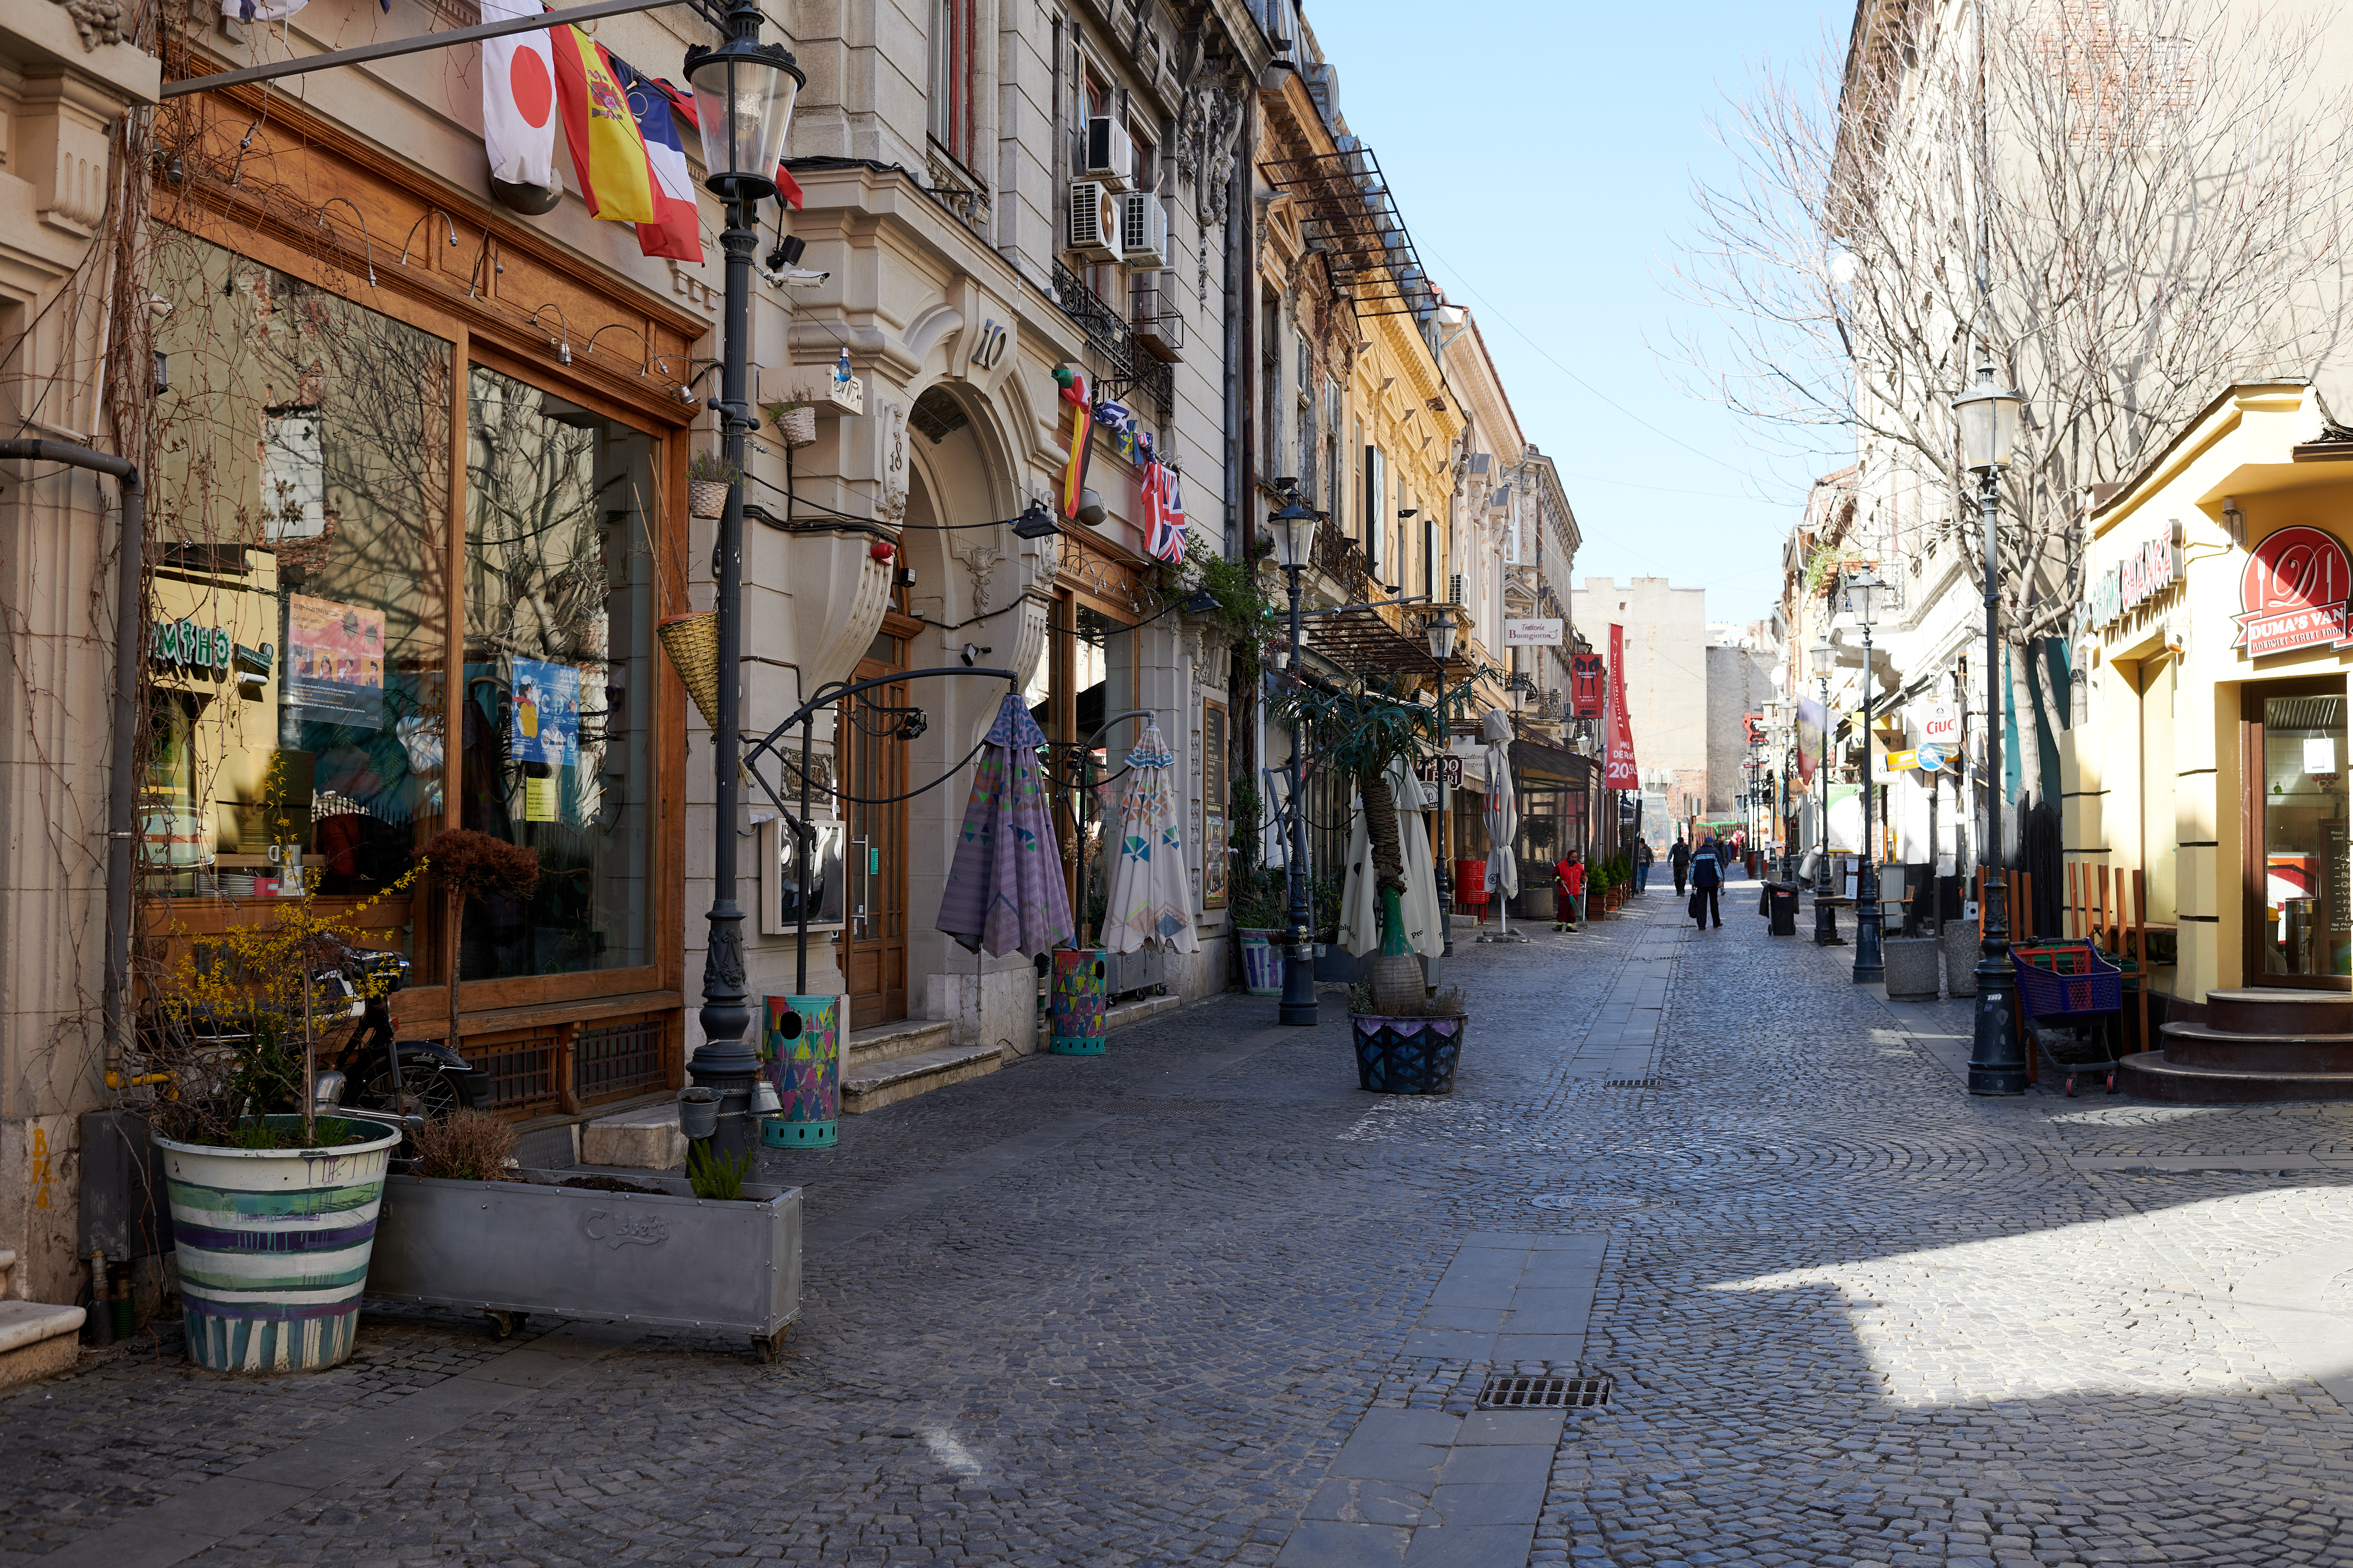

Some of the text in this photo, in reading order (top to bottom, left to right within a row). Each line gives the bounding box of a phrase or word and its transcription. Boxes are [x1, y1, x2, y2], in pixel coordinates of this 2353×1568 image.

[972, 319, 1009, 371] 10
[890, 440, 901, 472] 18
[2122, 520, 2173, 614] CHANGA
[293, 604, 339, 617] ATTENTION TRAVELLERS
[1509, 630, 1557, 640] Buongiorno
[2250, 607, 2344, 640] DUMA'S VAN
[2252, 626, 2343, 651] GOURMET STREET FOOD
[560, 669, 578, 679] COVID-19
[1613, 750, 1623, 758] DE
